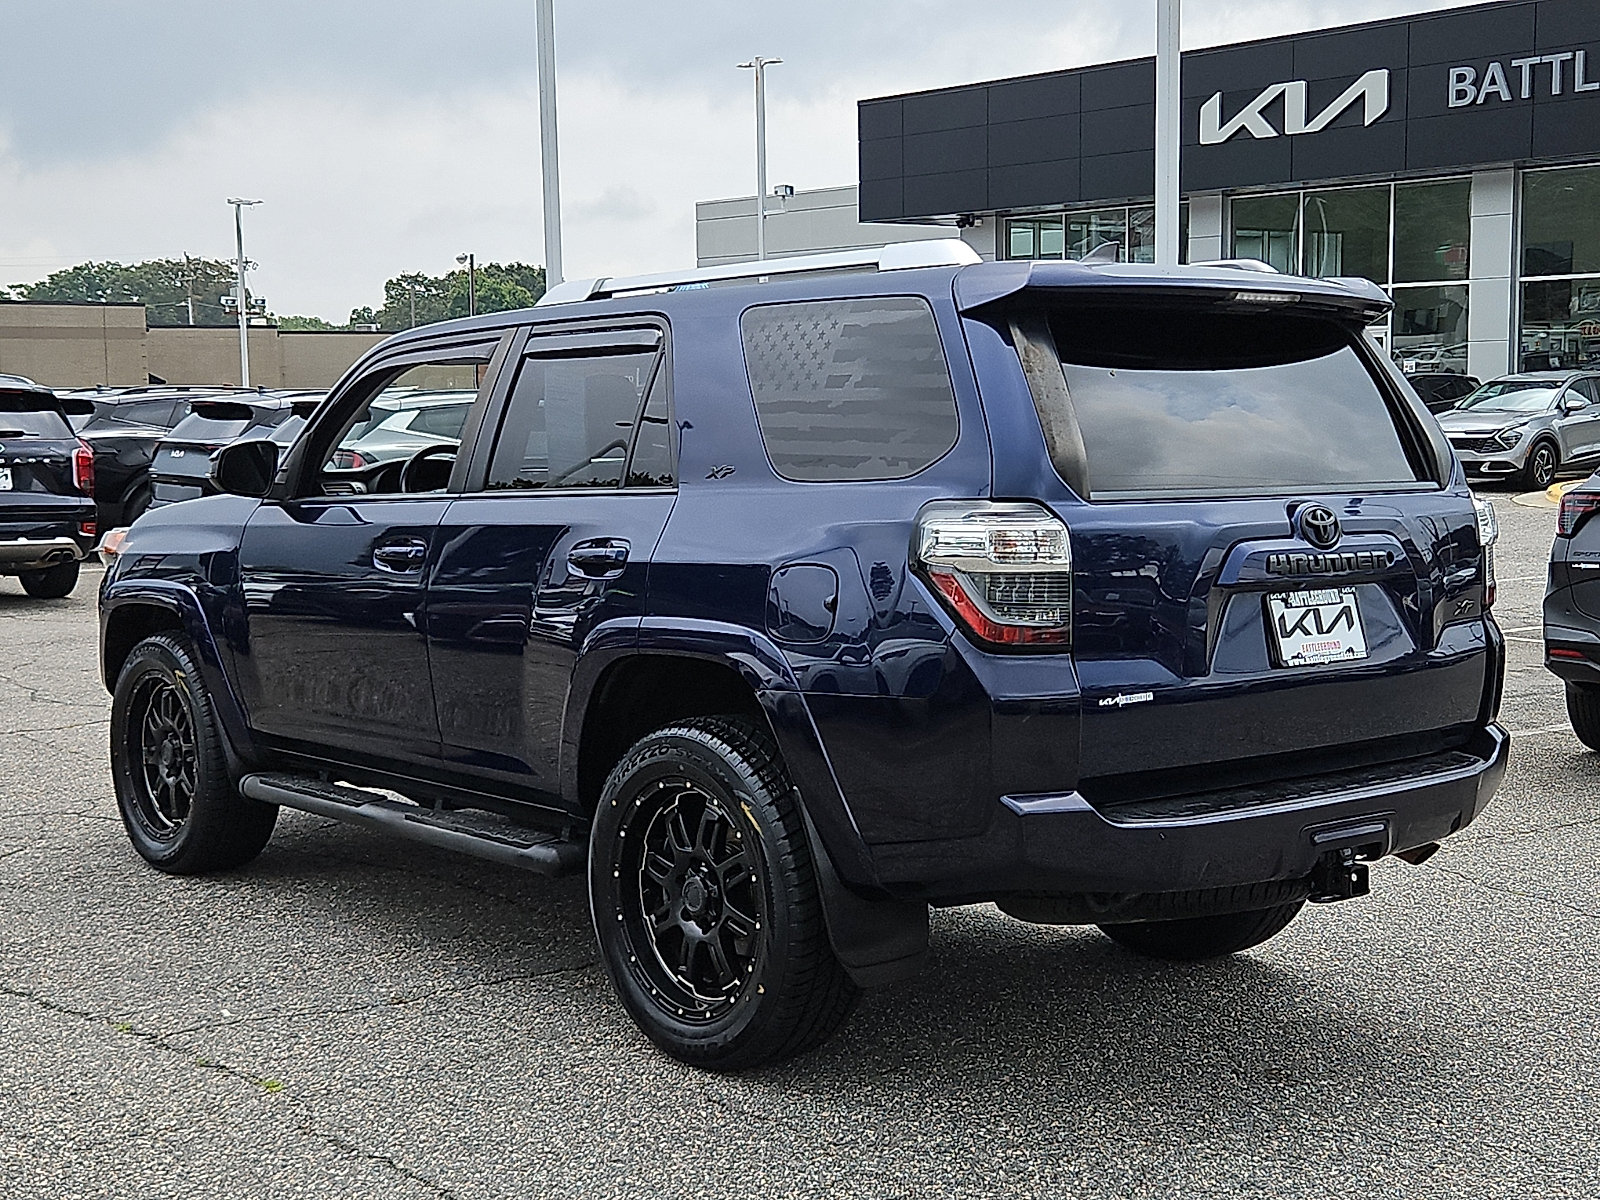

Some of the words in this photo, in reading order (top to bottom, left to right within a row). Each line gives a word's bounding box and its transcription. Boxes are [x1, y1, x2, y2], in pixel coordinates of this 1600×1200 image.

[1447, 50, 1600, 108] BATTL
[1199, 68, 1390, 145] KIA
[1267, 551, 1389, 576] 4RUNNER
[1277, 604, 1355, 639] KIA
